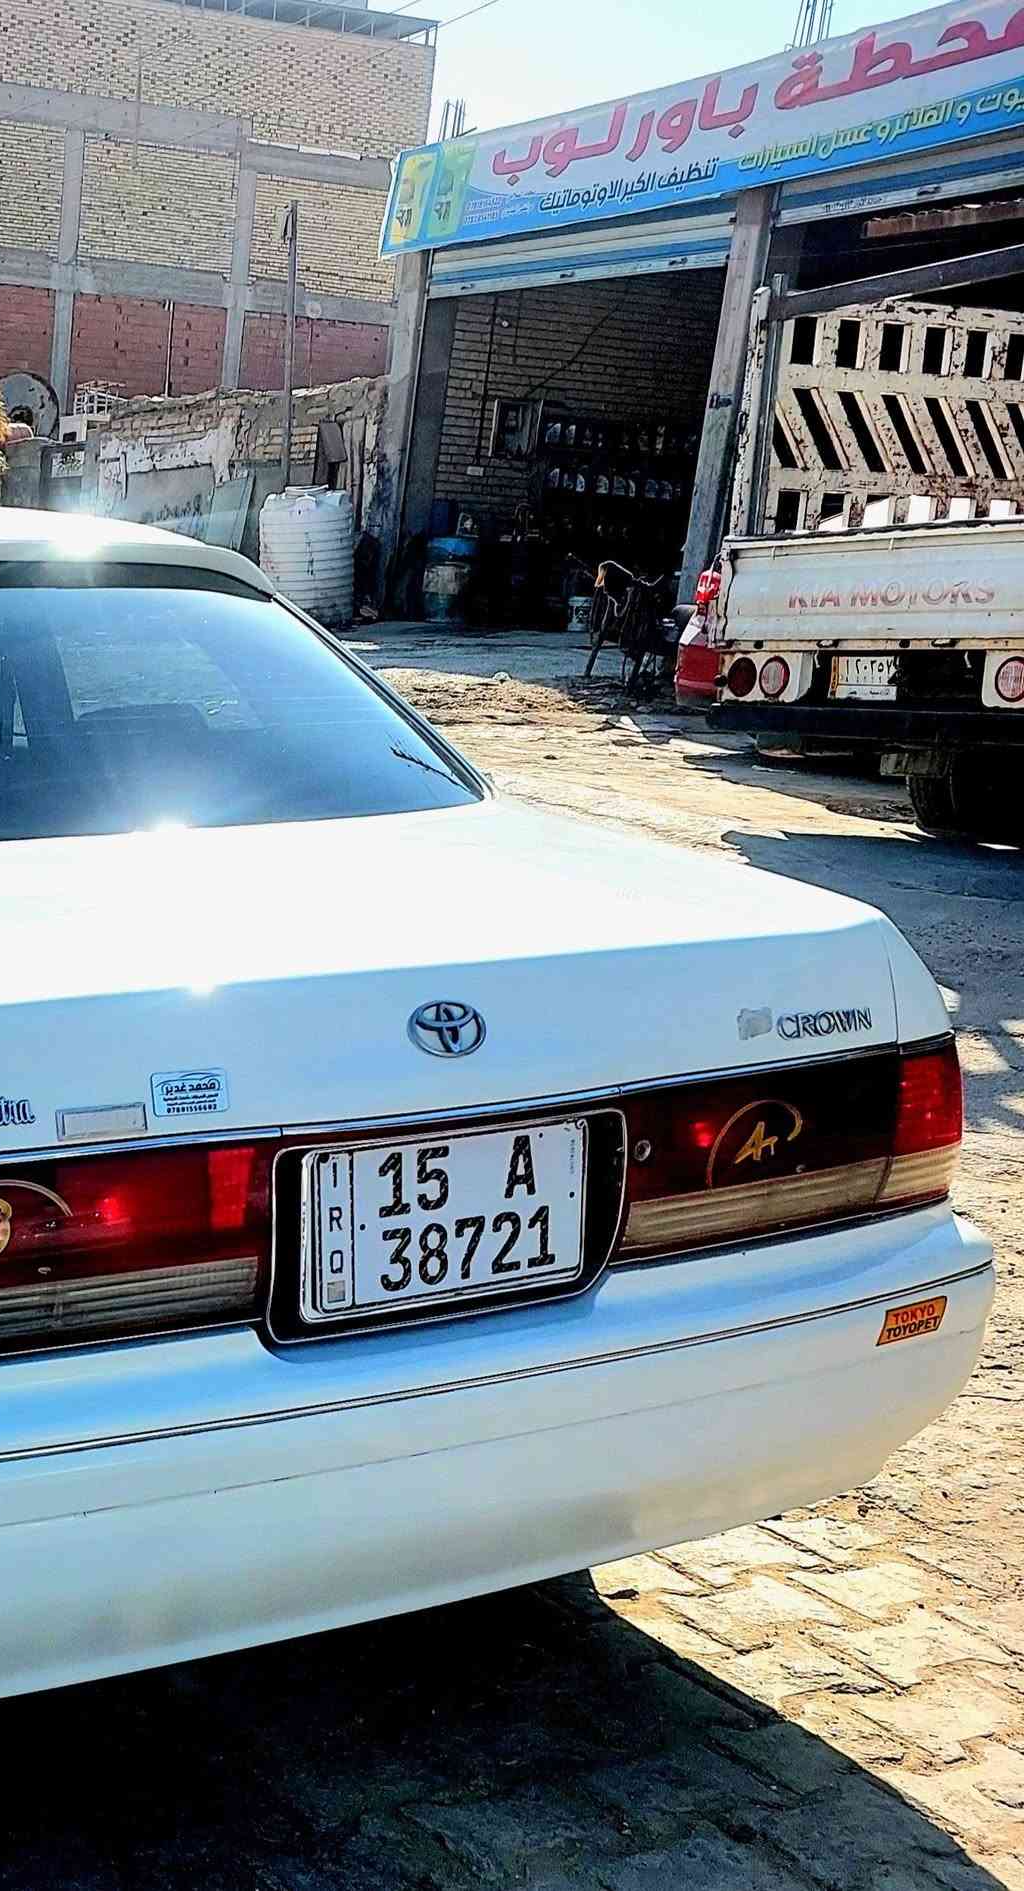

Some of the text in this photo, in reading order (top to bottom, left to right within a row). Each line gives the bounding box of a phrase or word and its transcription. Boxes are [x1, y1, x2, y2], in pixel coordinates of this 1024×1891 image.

[625, 77, 759, 162] باور
[492, 101, 630, 187] لوب
[738, 134, 817, 173] السيارات
[658, 156, 720, 192] تنظيف
[788, 579, 996, 609] KIA MOTORS
[776, 1006, 873, 1041] CROWN
[188, 1082, 216, 1092] محمد
[378, 1145, 450, 1218] 15
[503, 1134, 536, 1199] A
[380, 1205, 557, 1292] 38721
[885, 1315, 941, 1340] TOYOPET
[891, 1303, 936, 1325] TOKYO
